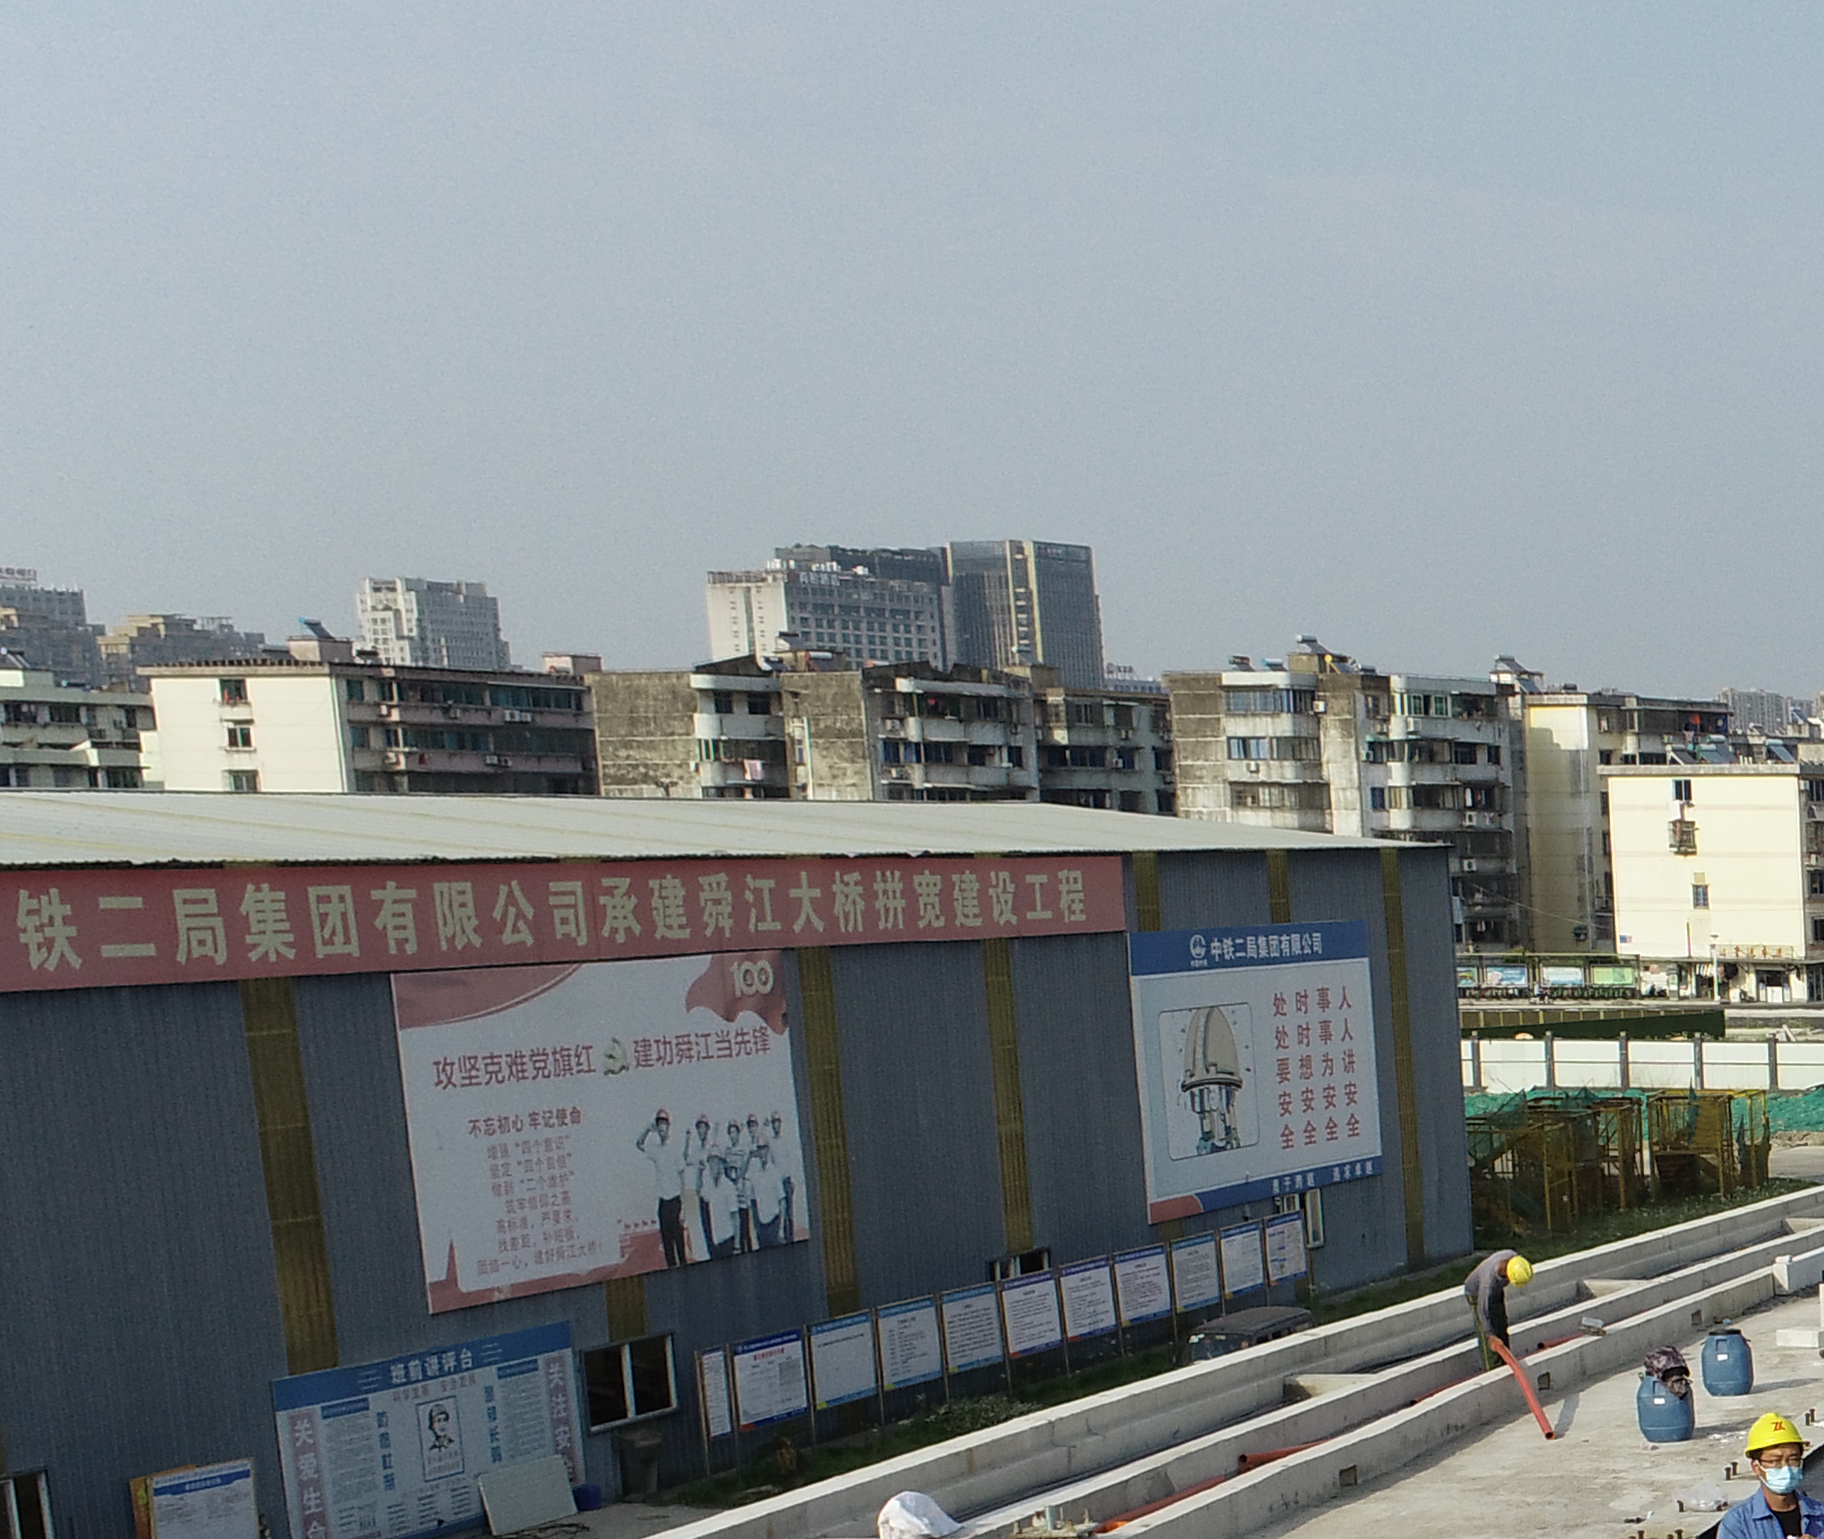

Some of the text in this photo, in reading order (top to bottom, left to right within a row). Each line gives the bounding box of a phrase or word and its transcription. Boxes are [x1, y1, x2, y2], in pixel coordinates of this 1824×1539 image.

[1210, 933, 1323, 962] 中铁二局集团有限公司
[433, 1025, 771, 1091] 攻坚克难党旗红 建功舜江当先锋
[468, 1105, 582, 1138] 不忘初心 牢记使命
[1273, 992, 1295, 1150] 处处要安全
[1295, 990, 1317, 1147] 时时想安全
[1317, 987, 1339, 1142] 事事为安全
[1339, 986, 1360, 1138] 人人讲安全
